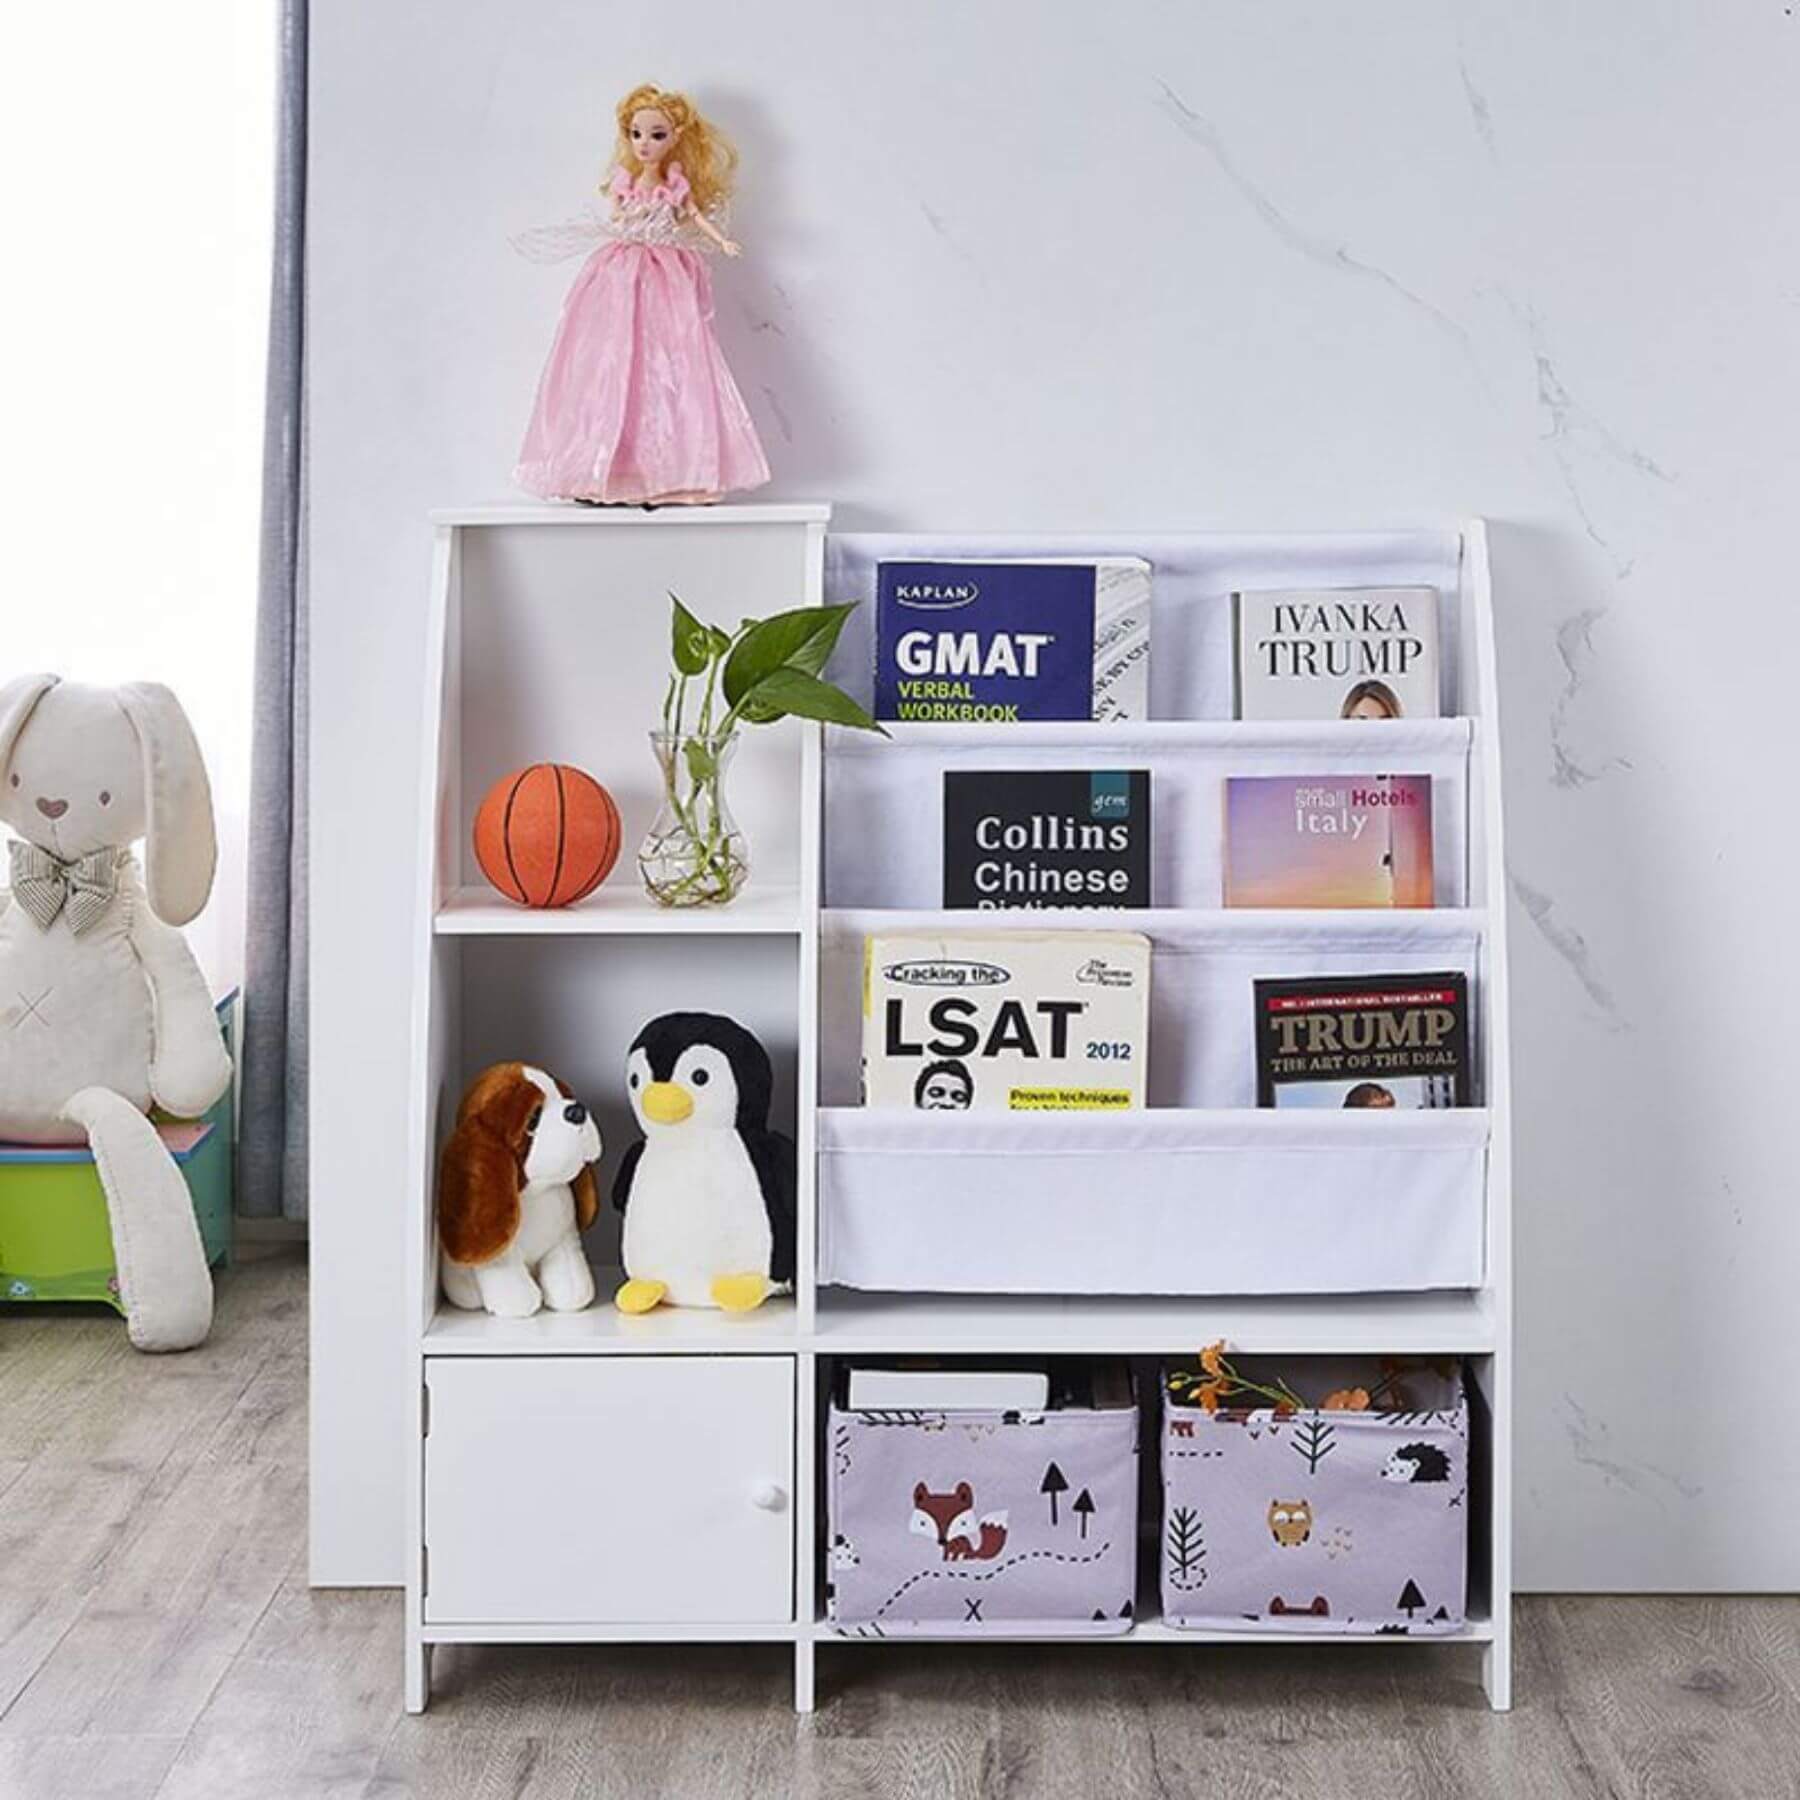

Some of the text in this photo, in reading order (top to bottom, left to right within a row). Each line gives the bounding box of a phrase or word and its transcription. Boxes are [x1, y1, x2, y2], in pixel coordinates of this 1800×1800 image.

[896, 585, 969, 599] KAPLAN
[1274, 603, 1409, 633] IVANKA
[896, 630, 1048, 677] GMAT
[1258, 637, 1424, 677] TRUMP
[897, 681, 975, 700] VERBAL
[897, 703, 1018, 721] WORKBOOK
[1351, 789, 1420, 807] Hotels
[975, 815, 1130, 851] Collins
[1296, 807, 1369, 841] Italy
[974, 861, 1130, 893] Chinese
[887, 964, 967, 986] Cracking
[971, 965, 1000, 984] the
[885, 997, 1084, 1059] LSAT
[1269, 1008, 1456, 1054] TRUMP
[1086, 1042, 1132, 1061] 2012
[1270, 1050, 1457, 1073] THE ART OF THE DEAL
[1010, 1088, 1130, 1105] Proven techniques
